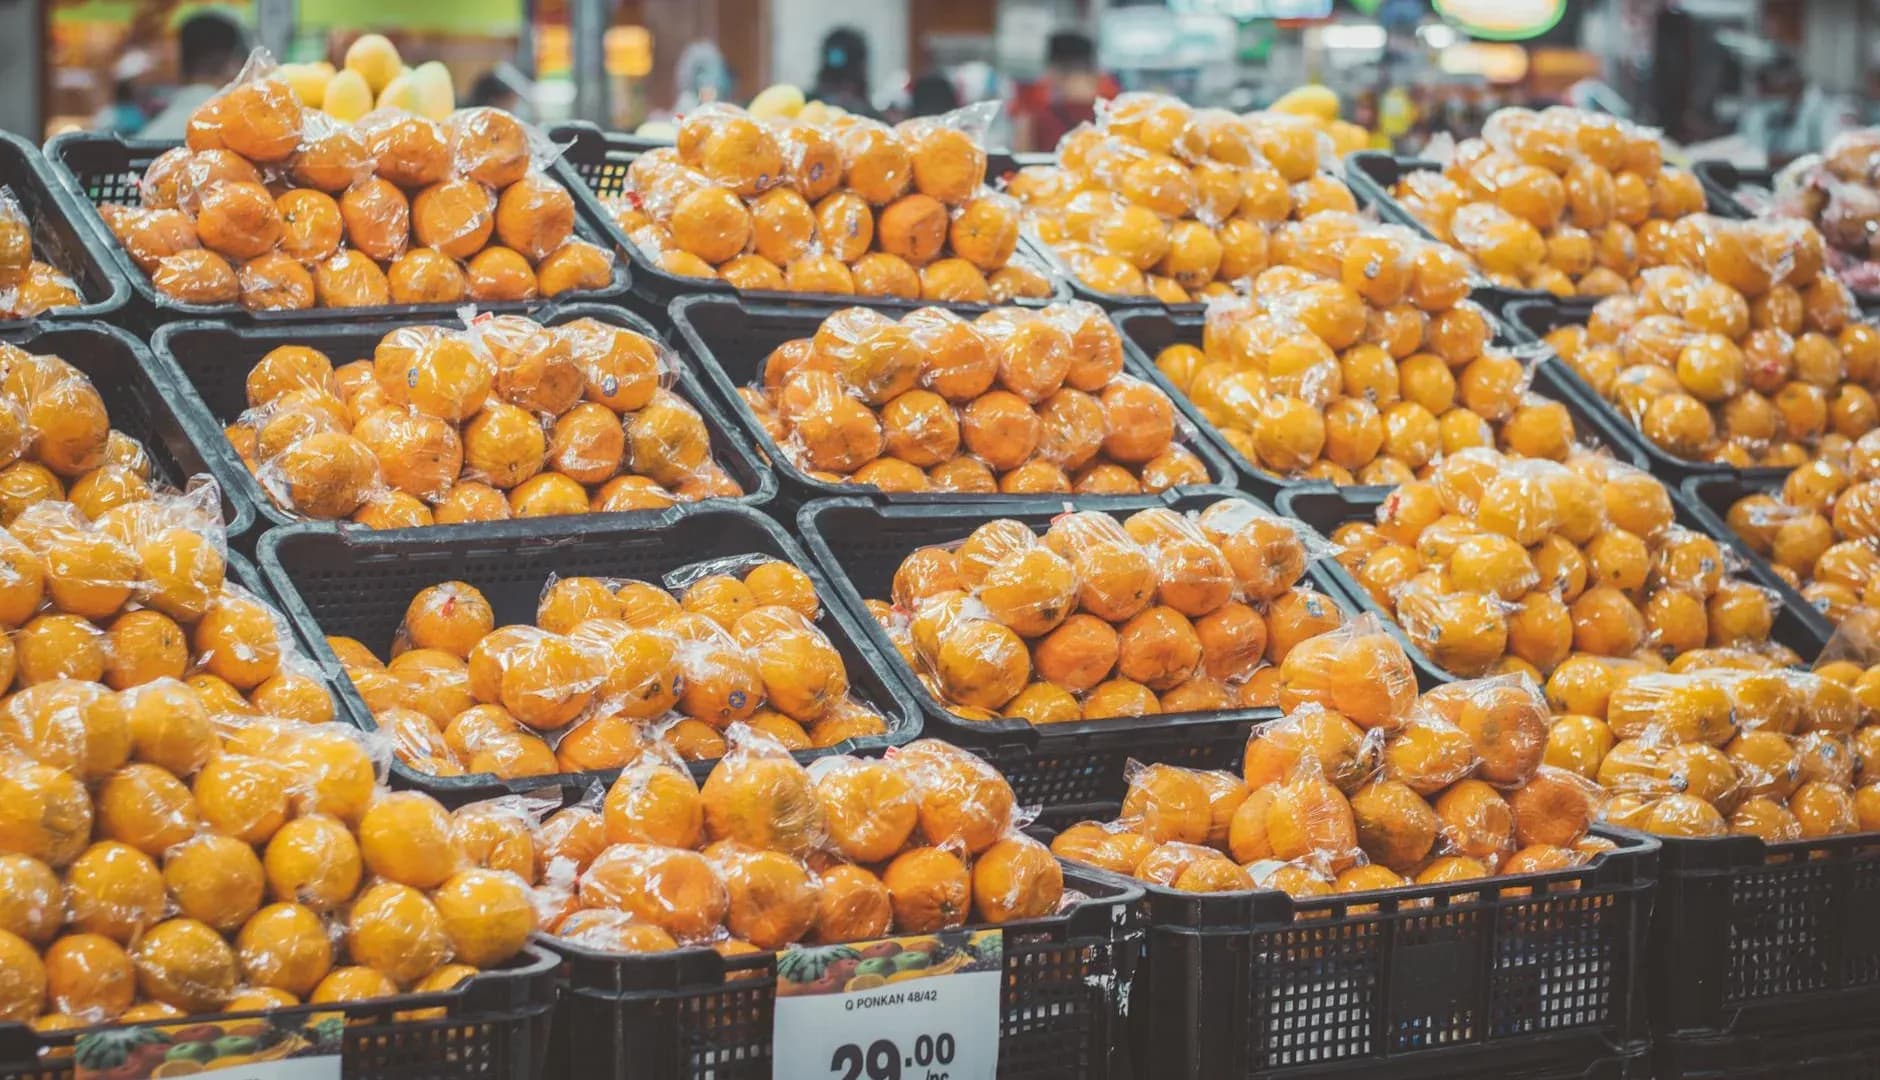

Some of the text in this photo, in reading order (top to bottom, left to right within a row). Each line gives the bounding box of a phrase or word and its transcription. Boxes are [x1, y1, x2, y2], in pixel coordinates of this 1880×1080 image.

[857, 993, 905, 1009] PONKAN
[907, 990, 937, 1003] 48/42
[830, 1032, 956, 1080] 29.00
